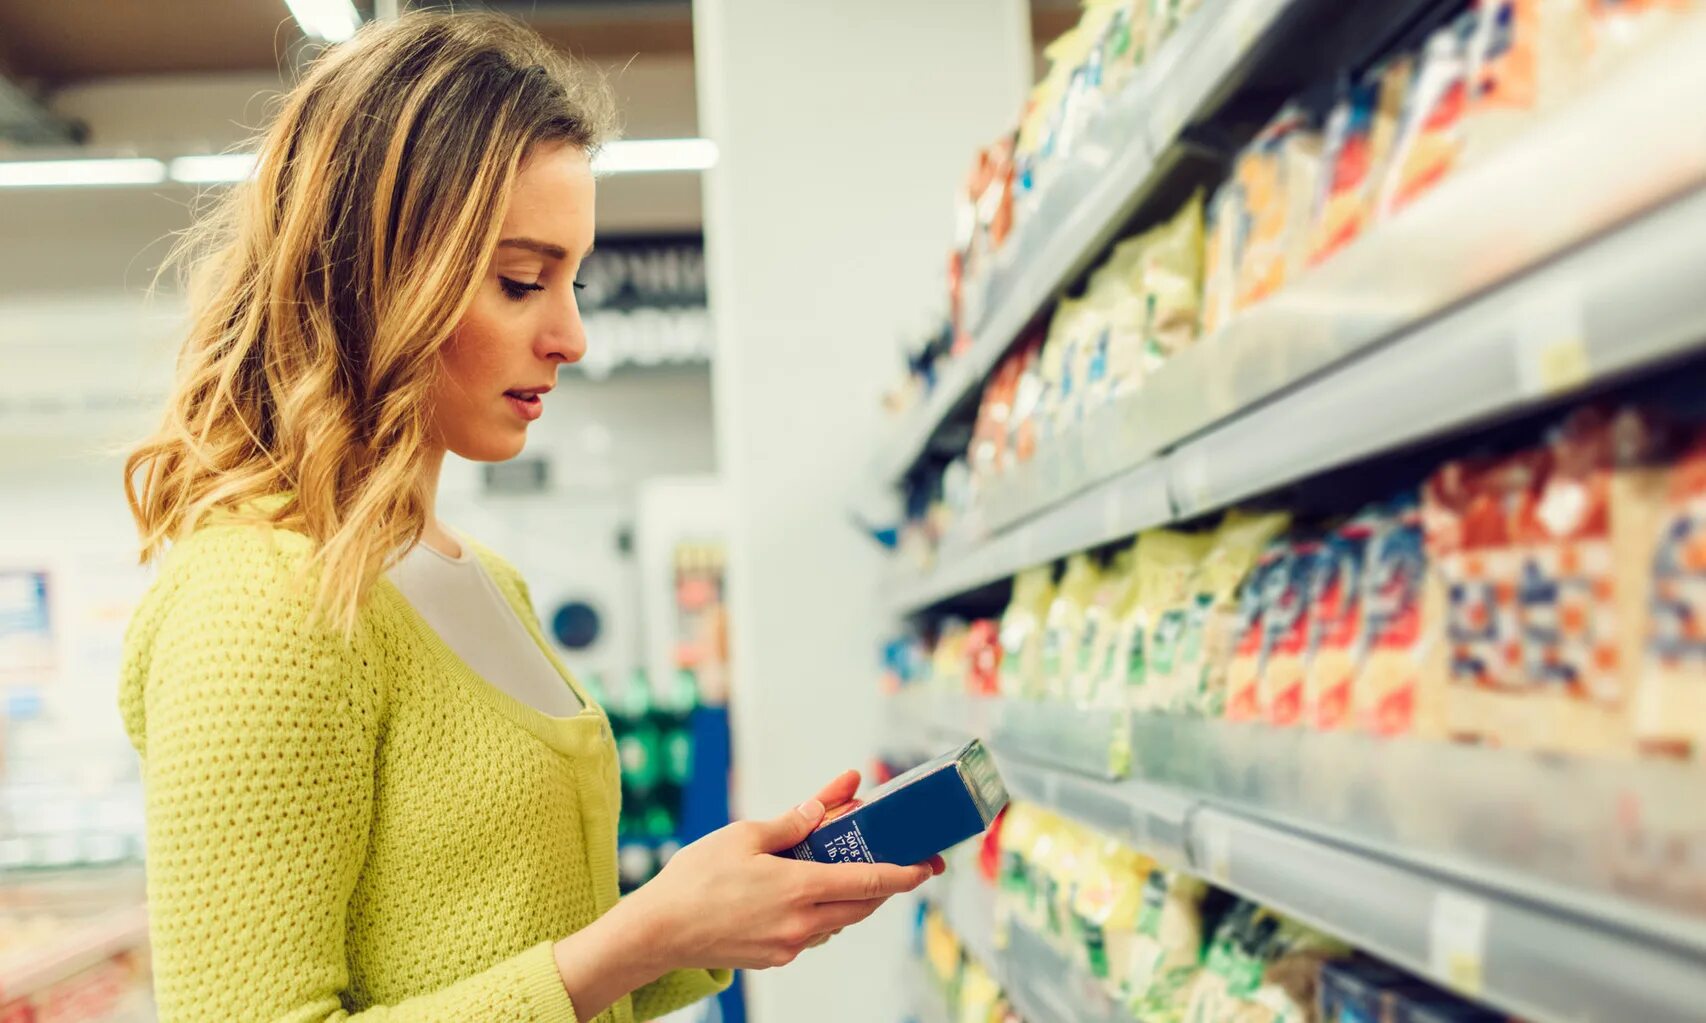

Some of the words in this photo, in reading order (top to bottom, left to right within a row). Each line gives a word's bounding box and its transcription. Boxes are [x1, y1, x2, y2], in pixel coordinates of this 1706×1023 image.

[834, 835, 850, 855] 17.6
[843, 831, 858, 849] 500
[828, 847, 838, 861] lb.
[850, 849, 860, 857] g
